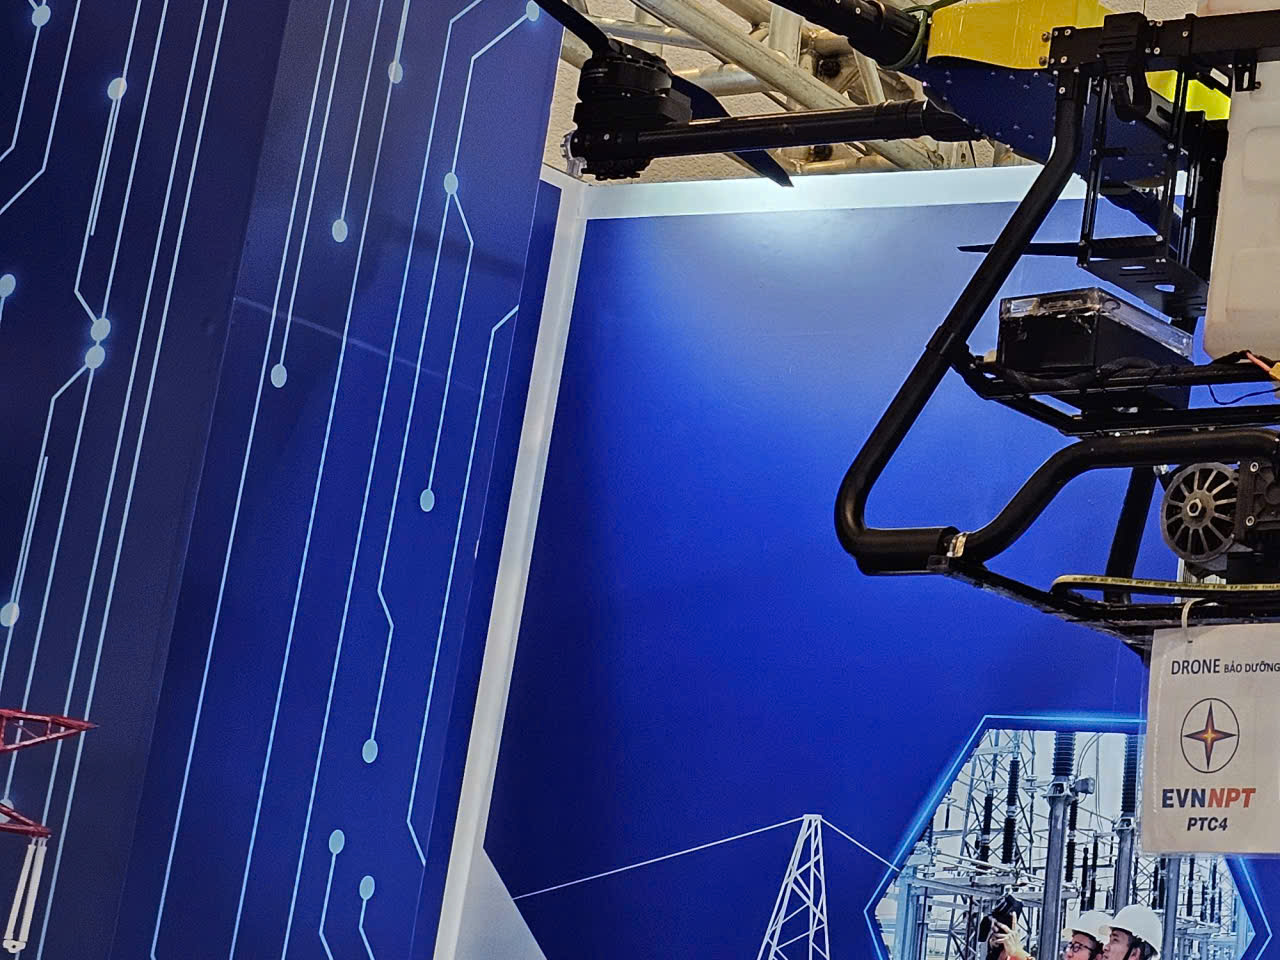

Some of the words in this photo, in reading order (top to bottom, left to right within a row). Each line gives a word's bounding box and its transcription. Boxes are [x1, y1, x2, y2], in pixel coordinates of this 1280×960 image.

[1171, 659, 1221, 675] DRONE
[1244, 660, 1280, 673] DƯỠNG
[1187, 816, 1228, 832] PTC4
